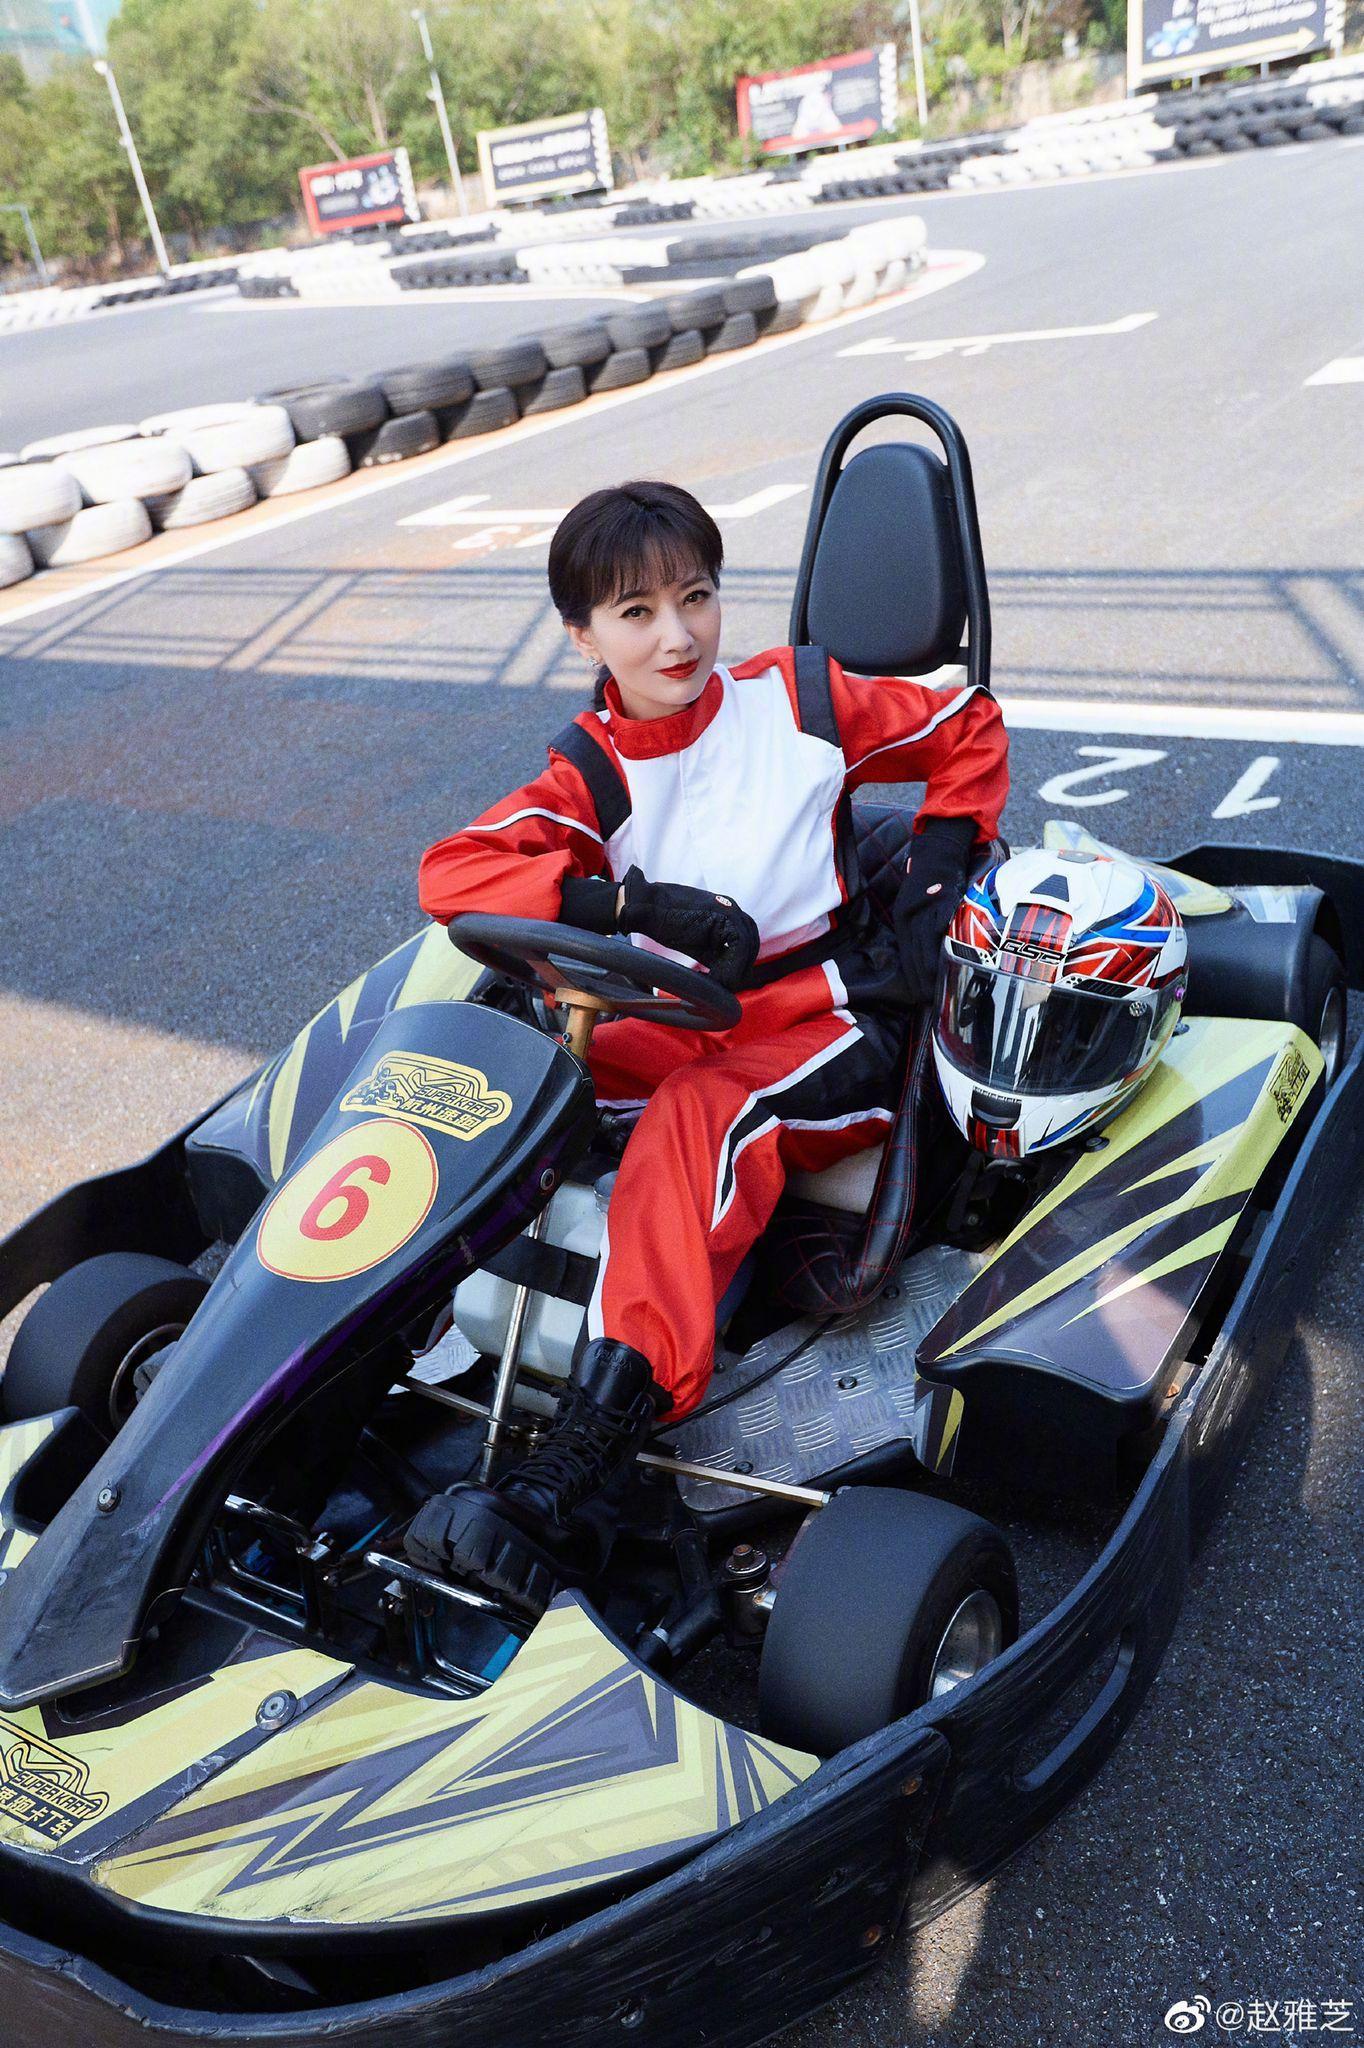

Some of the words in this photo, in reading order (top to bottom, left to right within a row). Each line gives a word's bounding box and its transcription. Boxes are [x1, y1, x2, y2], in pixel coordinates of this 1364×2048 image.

[415, 1086, 490, 1117] SUPERKART
[300, 1155, 391, 1241] 6
[14, 1771, 92, 1816] SUPERKART
